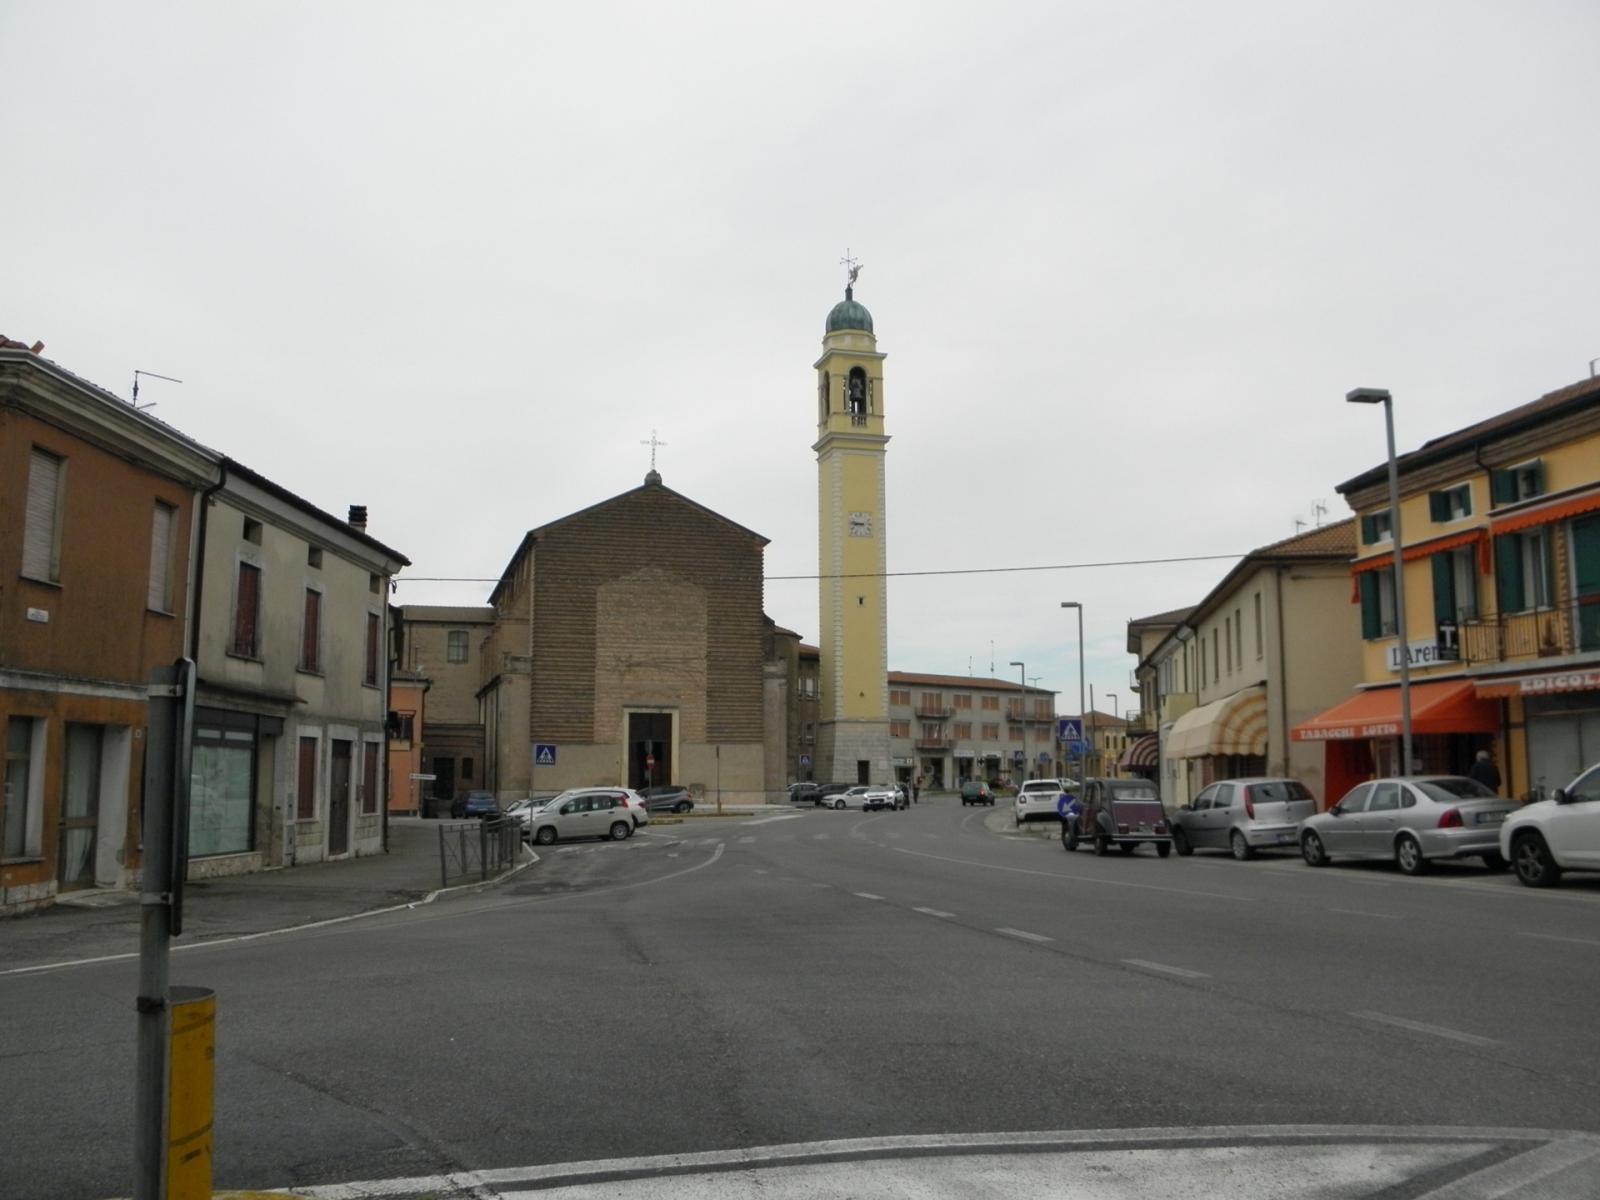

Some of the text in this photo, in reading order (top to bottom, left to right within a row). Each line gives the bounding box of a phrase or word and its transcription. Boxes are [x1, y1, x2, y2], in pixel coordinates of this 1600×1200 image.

[1520, 674, 1600, 692] EDICOL
[1300, 723, 1397, 739] TABACCHI LOTTO
